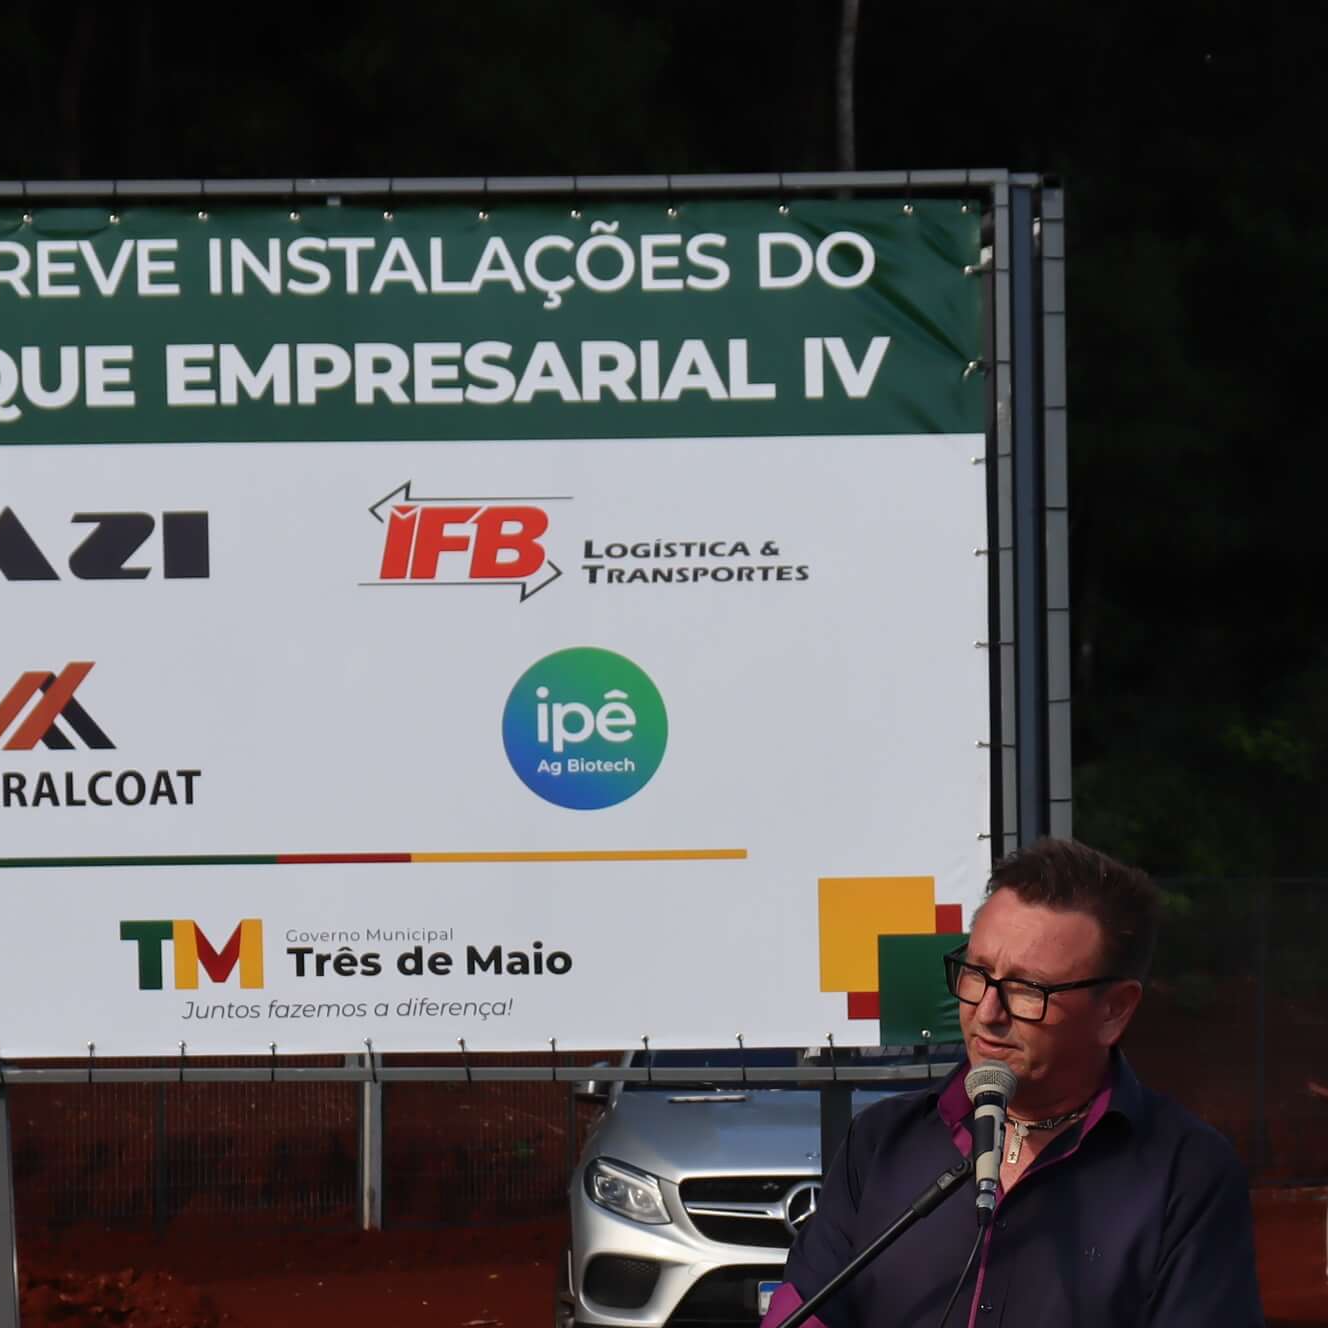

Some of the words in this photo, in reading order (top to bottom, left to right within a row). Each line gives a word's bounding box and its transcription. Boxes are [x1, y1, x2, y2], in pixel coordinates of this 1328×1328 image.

[209, 220, 730, 309] INSTALAÇÕES
[758, 231, 876, 290] DO
[166, 339, 776, 407] EMPRESARIAL
[803, 336, 891, 399] IV
[760, 541, 780, 555] &
[536, 686, 636, 752] ipê
[537, 758, 563, 777] Ag
[567, 756, 636, 774] Biotech
[285, 929, 361, 943] Governo
[366, 927, 454, 944] Municipal
[119, 918, 264, 990] TM
[287, 946, 383, 977] Três
[397, 945, 452, 976] de
[467, 941, 573, 975] Maio
[182, 1001, 261, 1020] Juntos
[267, 1000, 367, 1020] fazemos
[374, 1002, 388, 1017] a
[395, 998, 513, 1021] diferença!
